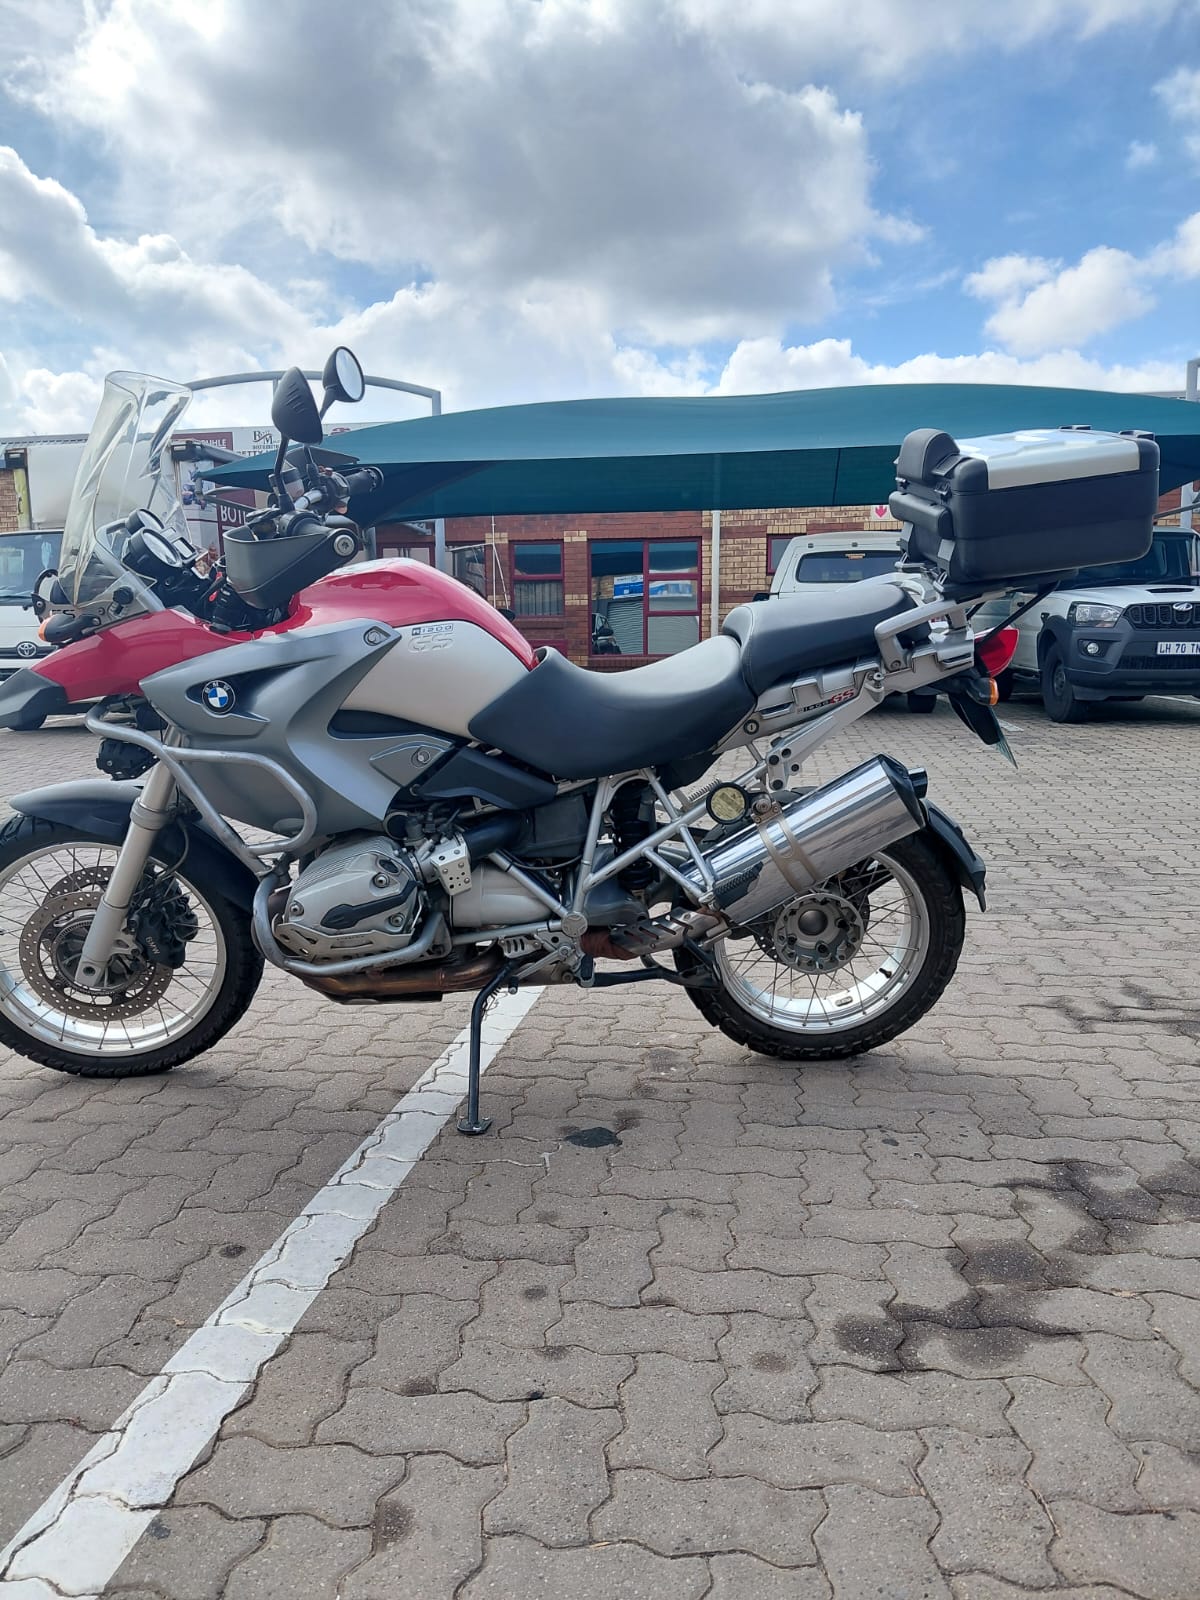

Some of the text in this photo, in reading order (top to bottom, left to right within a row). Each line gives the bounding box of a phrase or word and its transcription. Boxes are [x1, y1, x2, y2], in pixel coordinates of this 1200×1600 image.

[408, 633, 454, 653] GS
[1159, 643, 1171, 653] LH
[1175, 643, 1187, 653] 70
[203, 681, 232, 694] BMW
[145, 936, 161, 955] BMW
